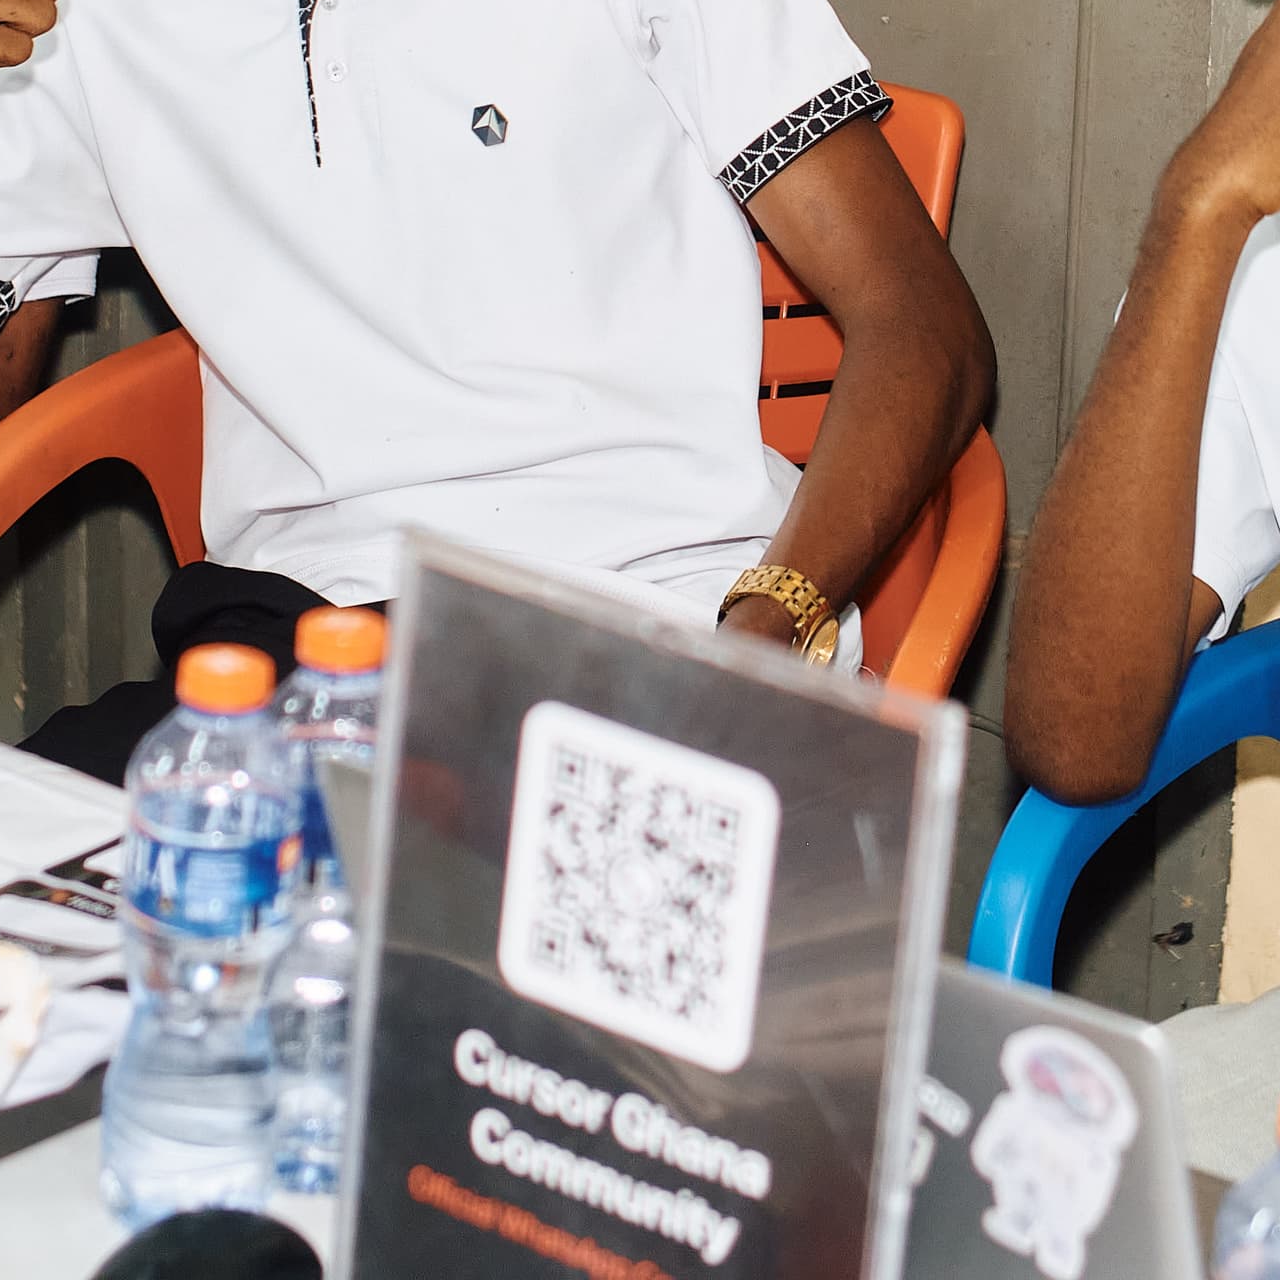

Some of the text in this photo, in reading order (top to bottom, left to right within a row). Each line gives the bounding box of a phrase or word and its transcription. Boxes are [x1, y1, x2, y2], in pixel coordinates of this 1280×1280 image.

[453, 1027, 772, 1200] Cursor Ghana
[469, 1107, 740, 1267] Community
